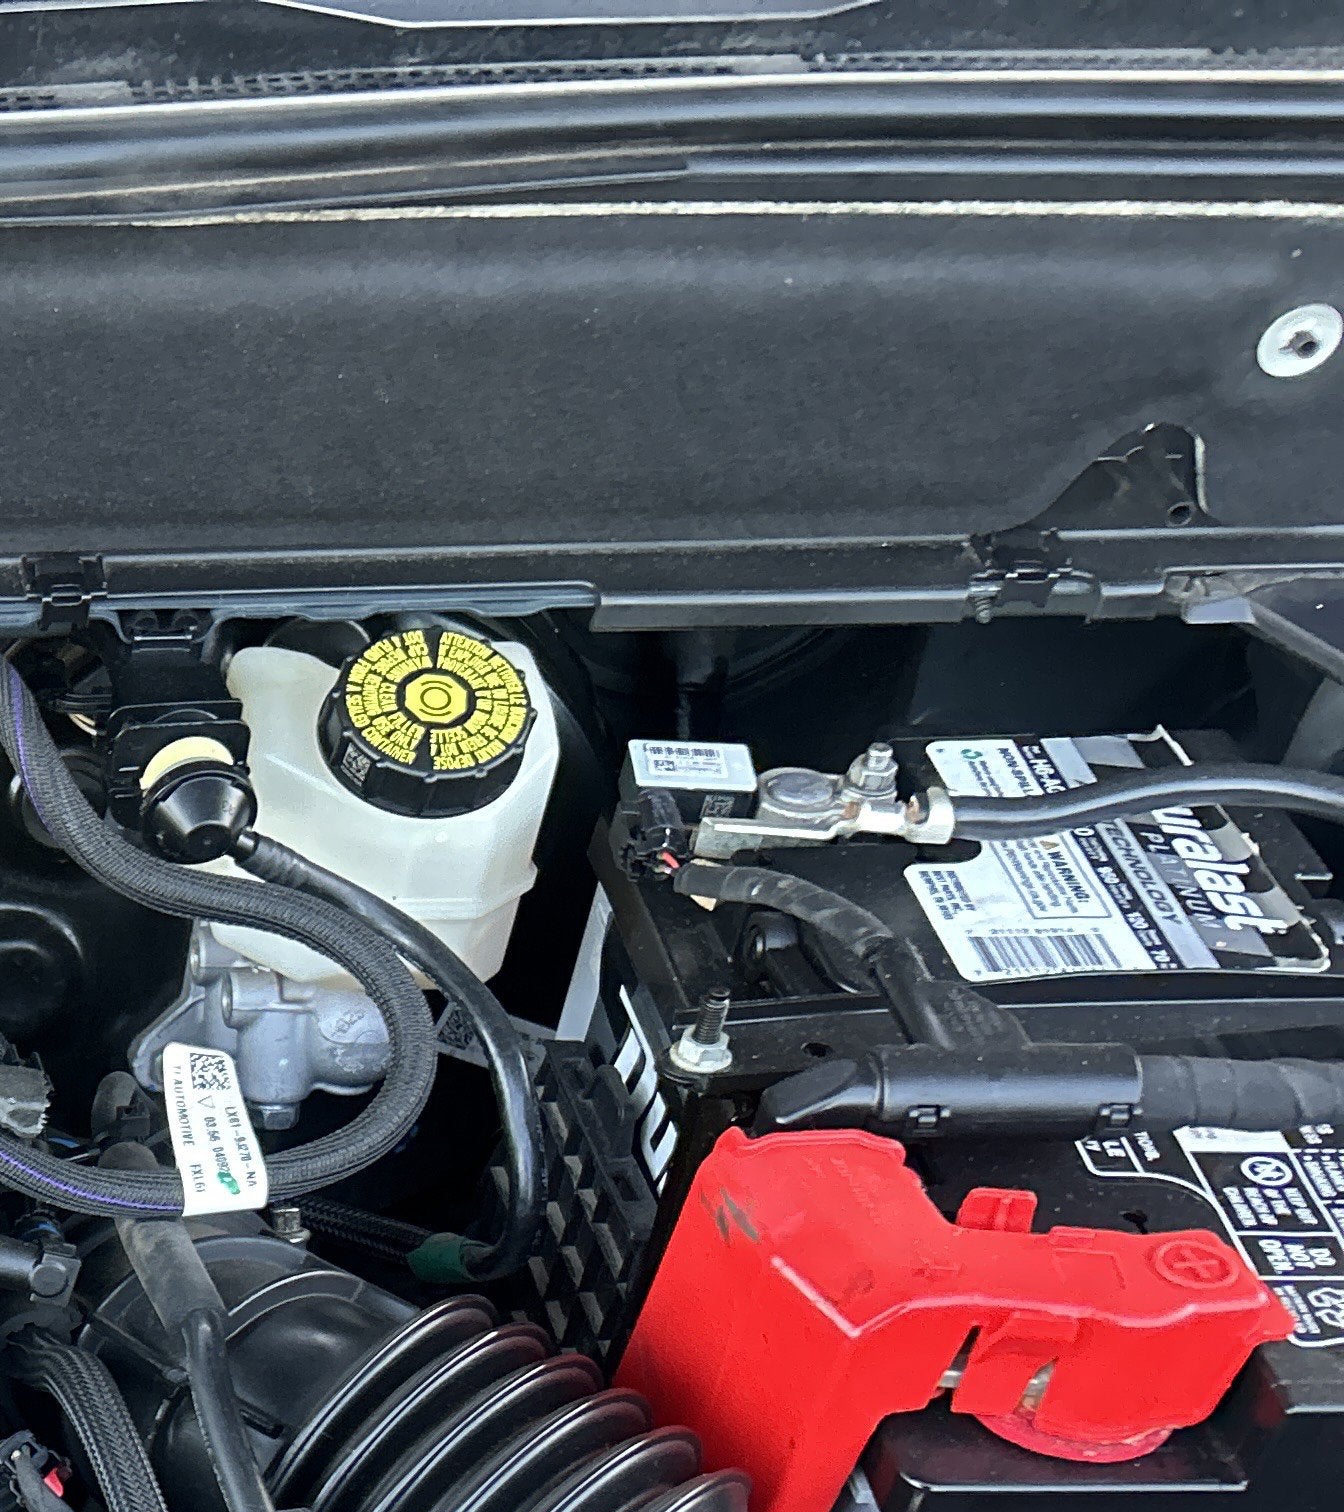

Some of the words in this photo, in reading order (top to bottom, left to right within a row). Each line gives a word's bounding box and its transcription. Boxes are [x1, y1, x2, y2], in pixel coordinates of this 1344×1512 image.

[1051, 851, 1090, 903] WARNING:
[1140, 832, 1222, 929] PLATINUM
[174, 1079, 195, 1146] AUTOMOTIVE
[1283, 1244, 1315, 1269] NOT
[1310, 1248, 1337, 1266] DO
